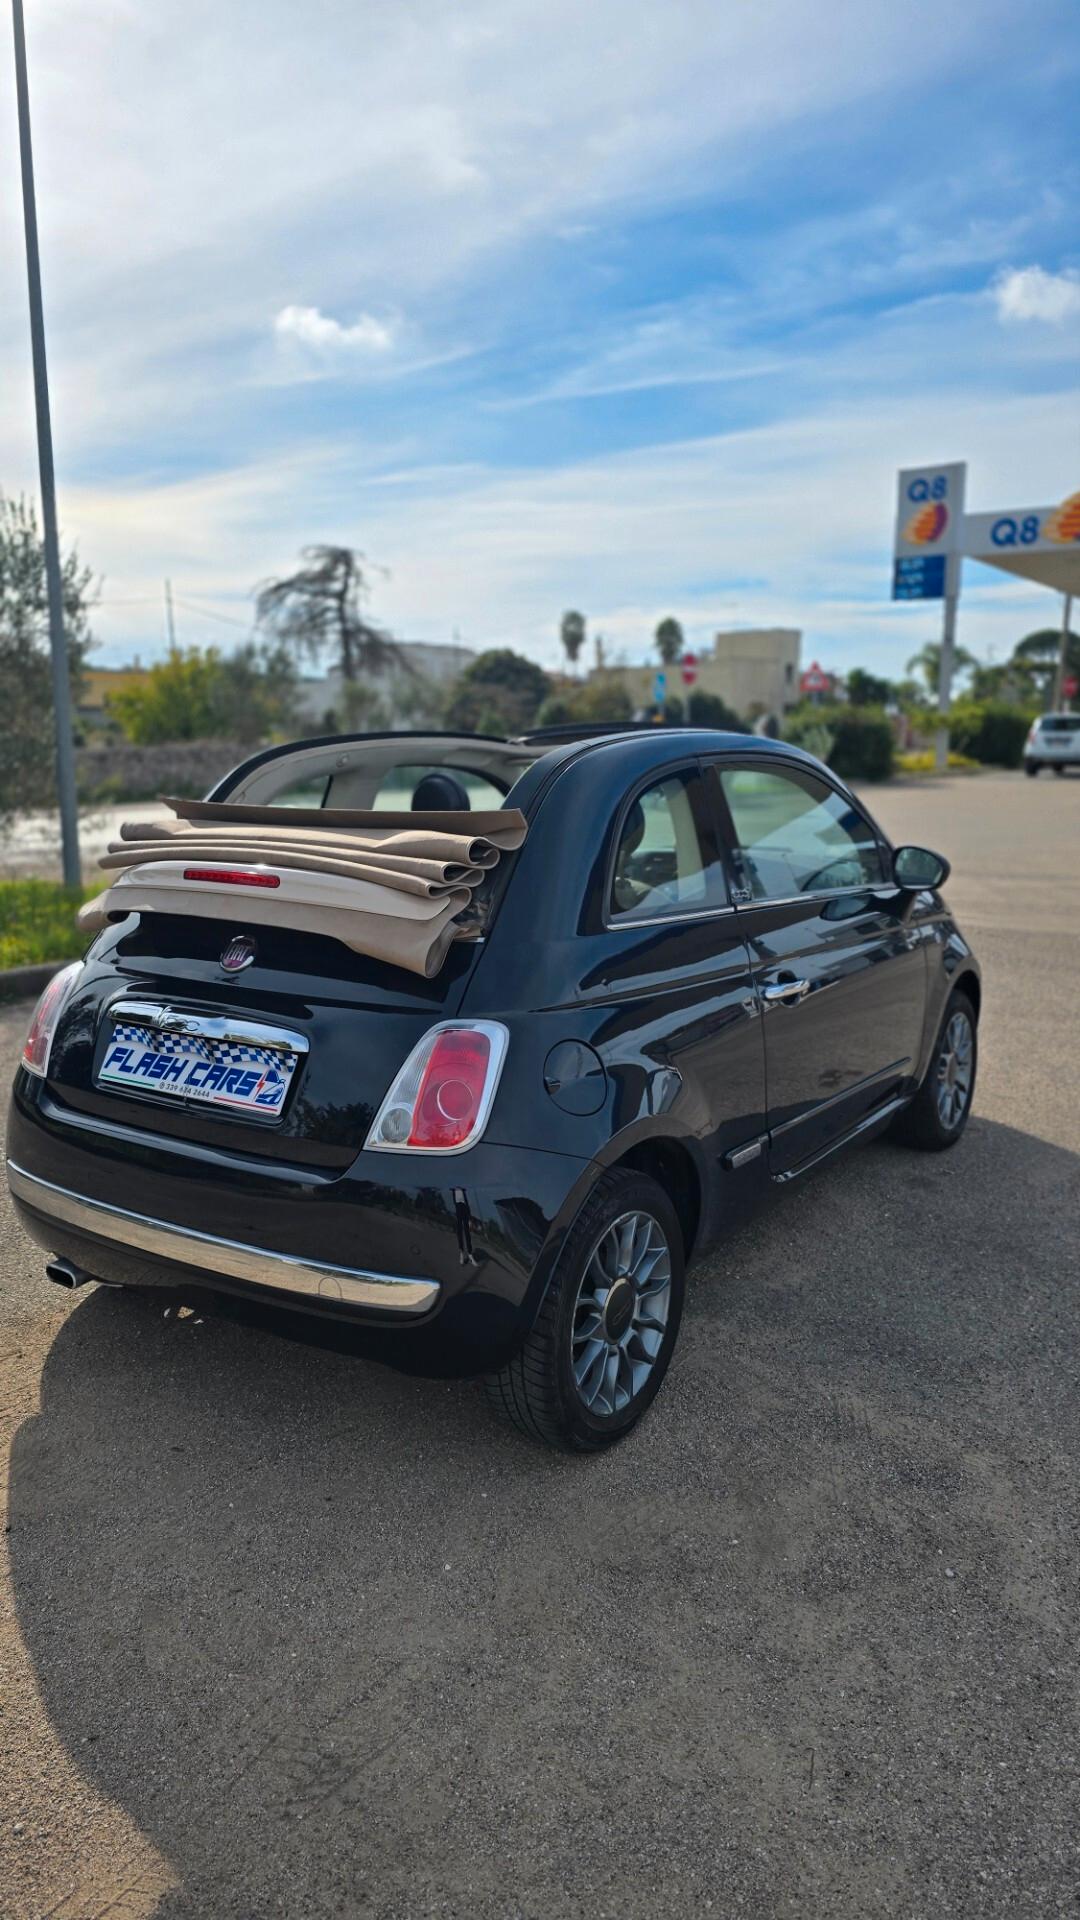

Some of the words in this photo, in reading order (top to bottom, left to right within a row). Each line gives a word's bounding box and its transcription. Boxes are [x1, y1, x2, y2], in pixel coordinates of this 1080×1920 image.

[908, 476, 947, 503] Q8
[990, 514, 1040, 547] Q8
[104, 1046, 188, 1082] FLASH
[185, 1061, 264, 1097] CARS
